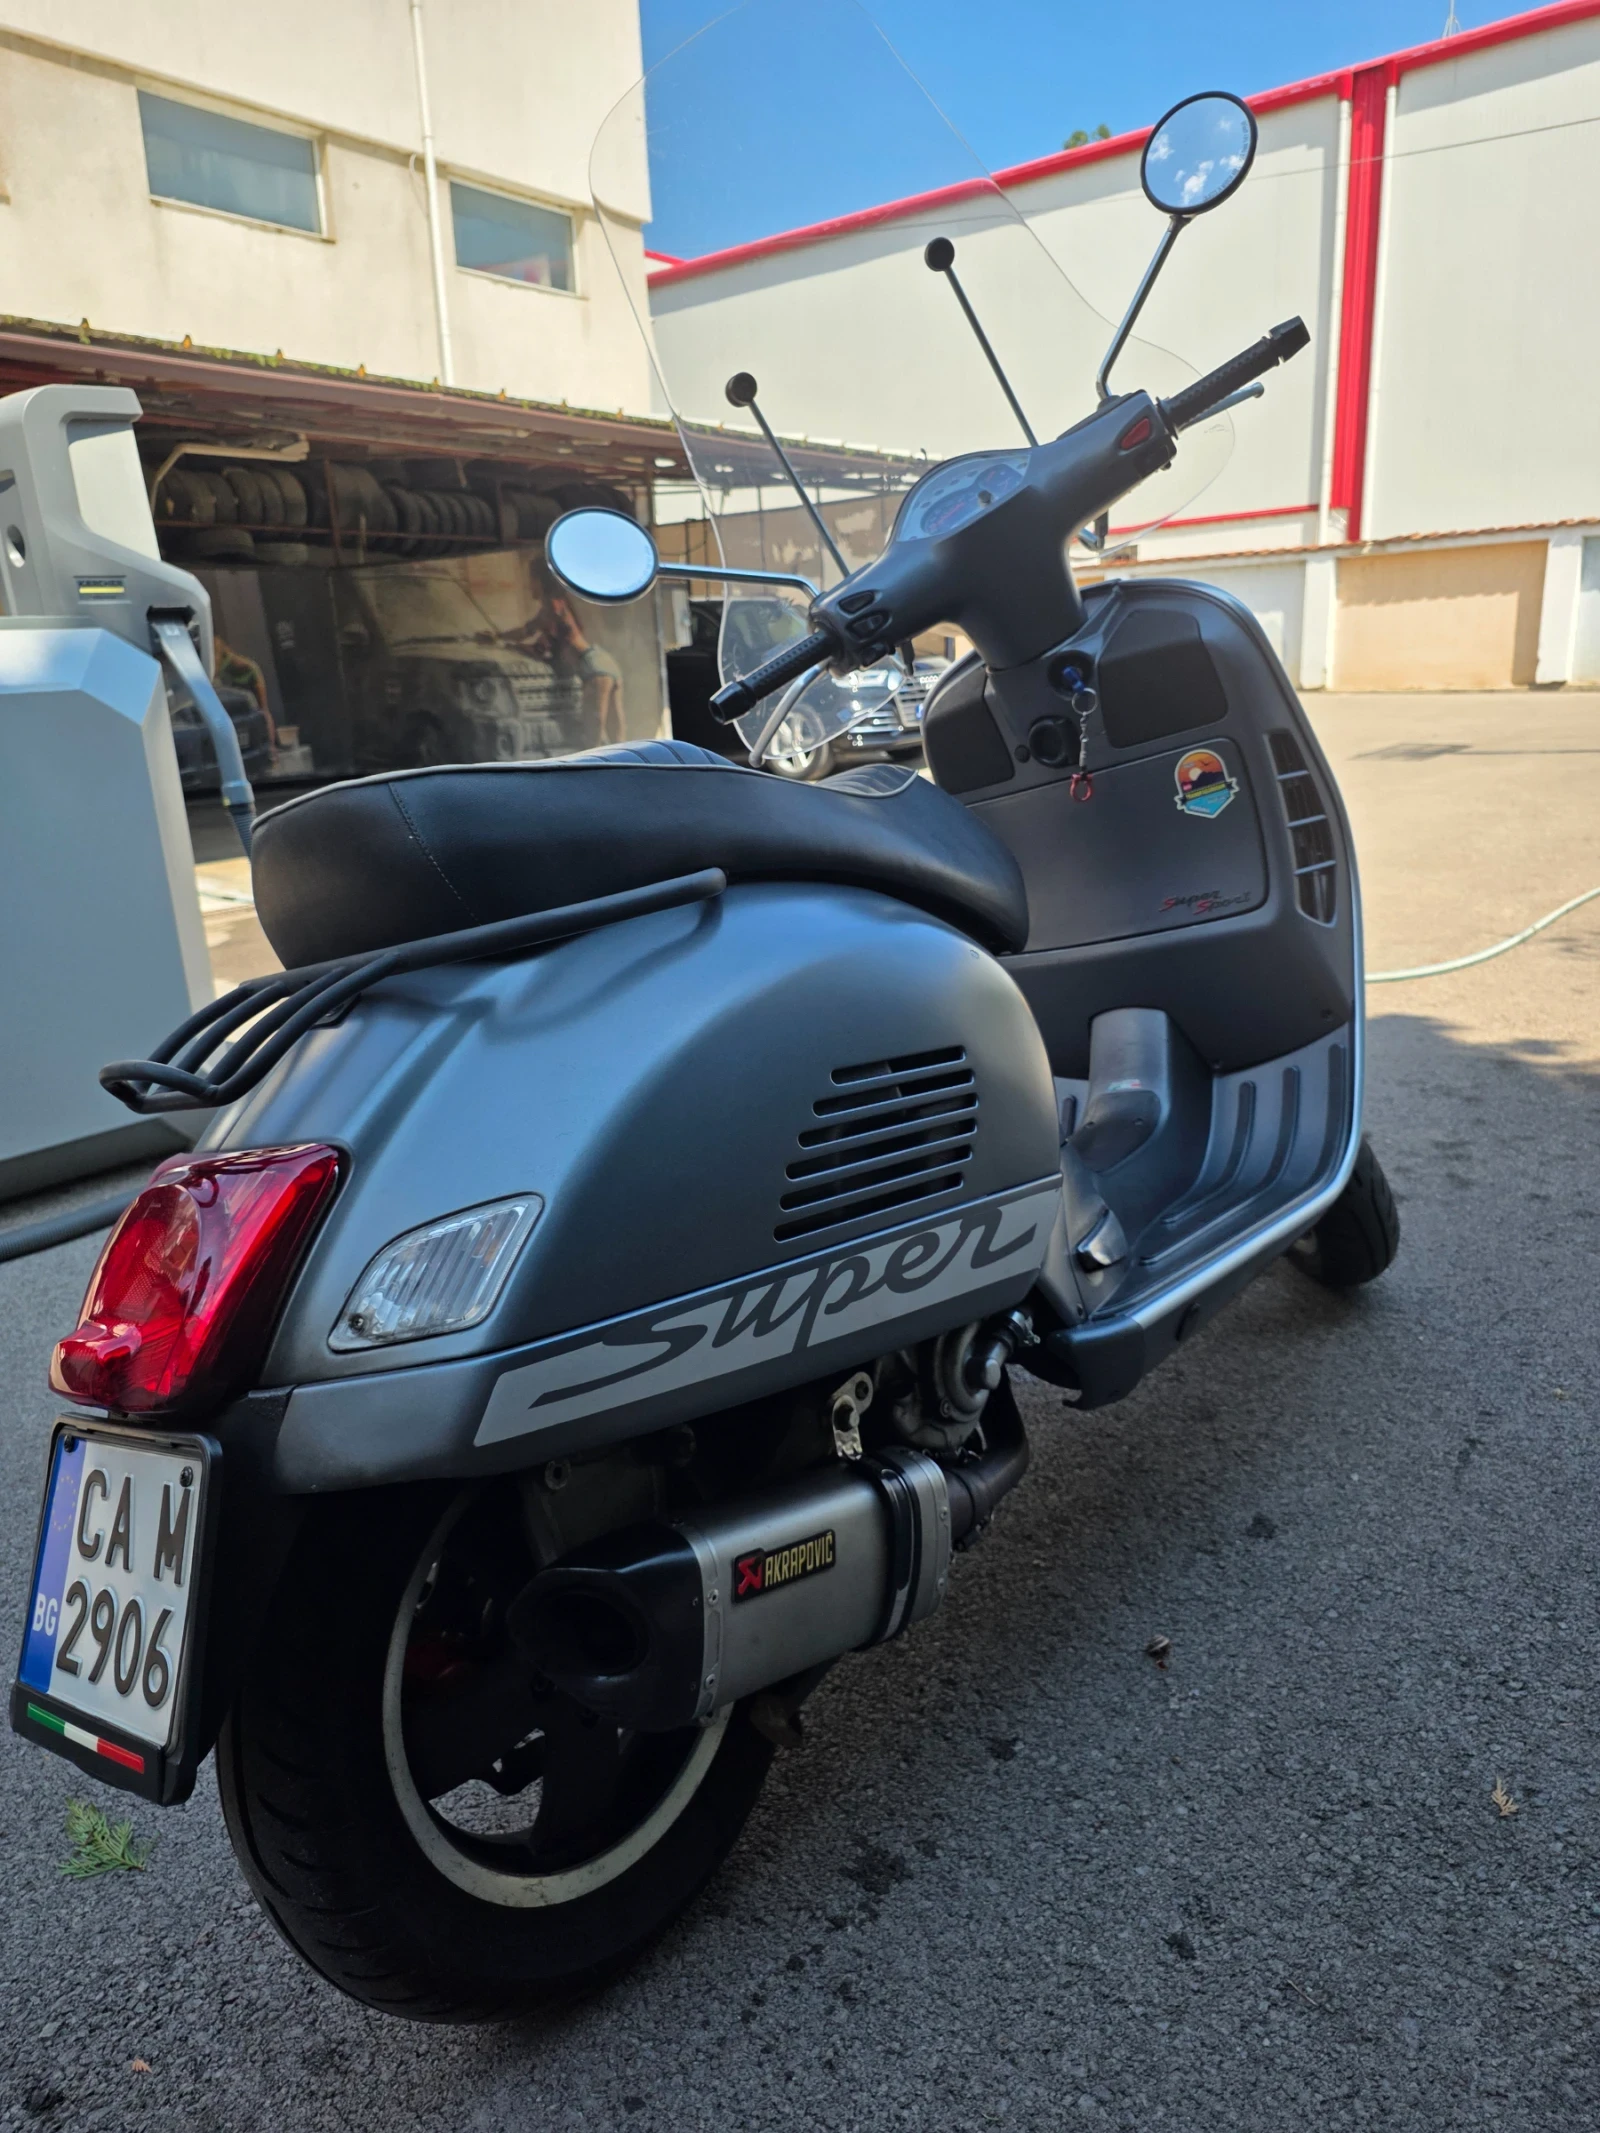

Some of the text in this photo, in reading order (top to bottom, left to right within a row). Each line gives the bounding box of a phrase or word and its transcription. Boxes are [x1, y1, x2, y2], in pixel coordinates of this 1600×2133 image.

[77, 1468, 192, 1586] CA M
[32, 1593, 58, 1636] BG
[56, 1580, 173, 1708] 2906
